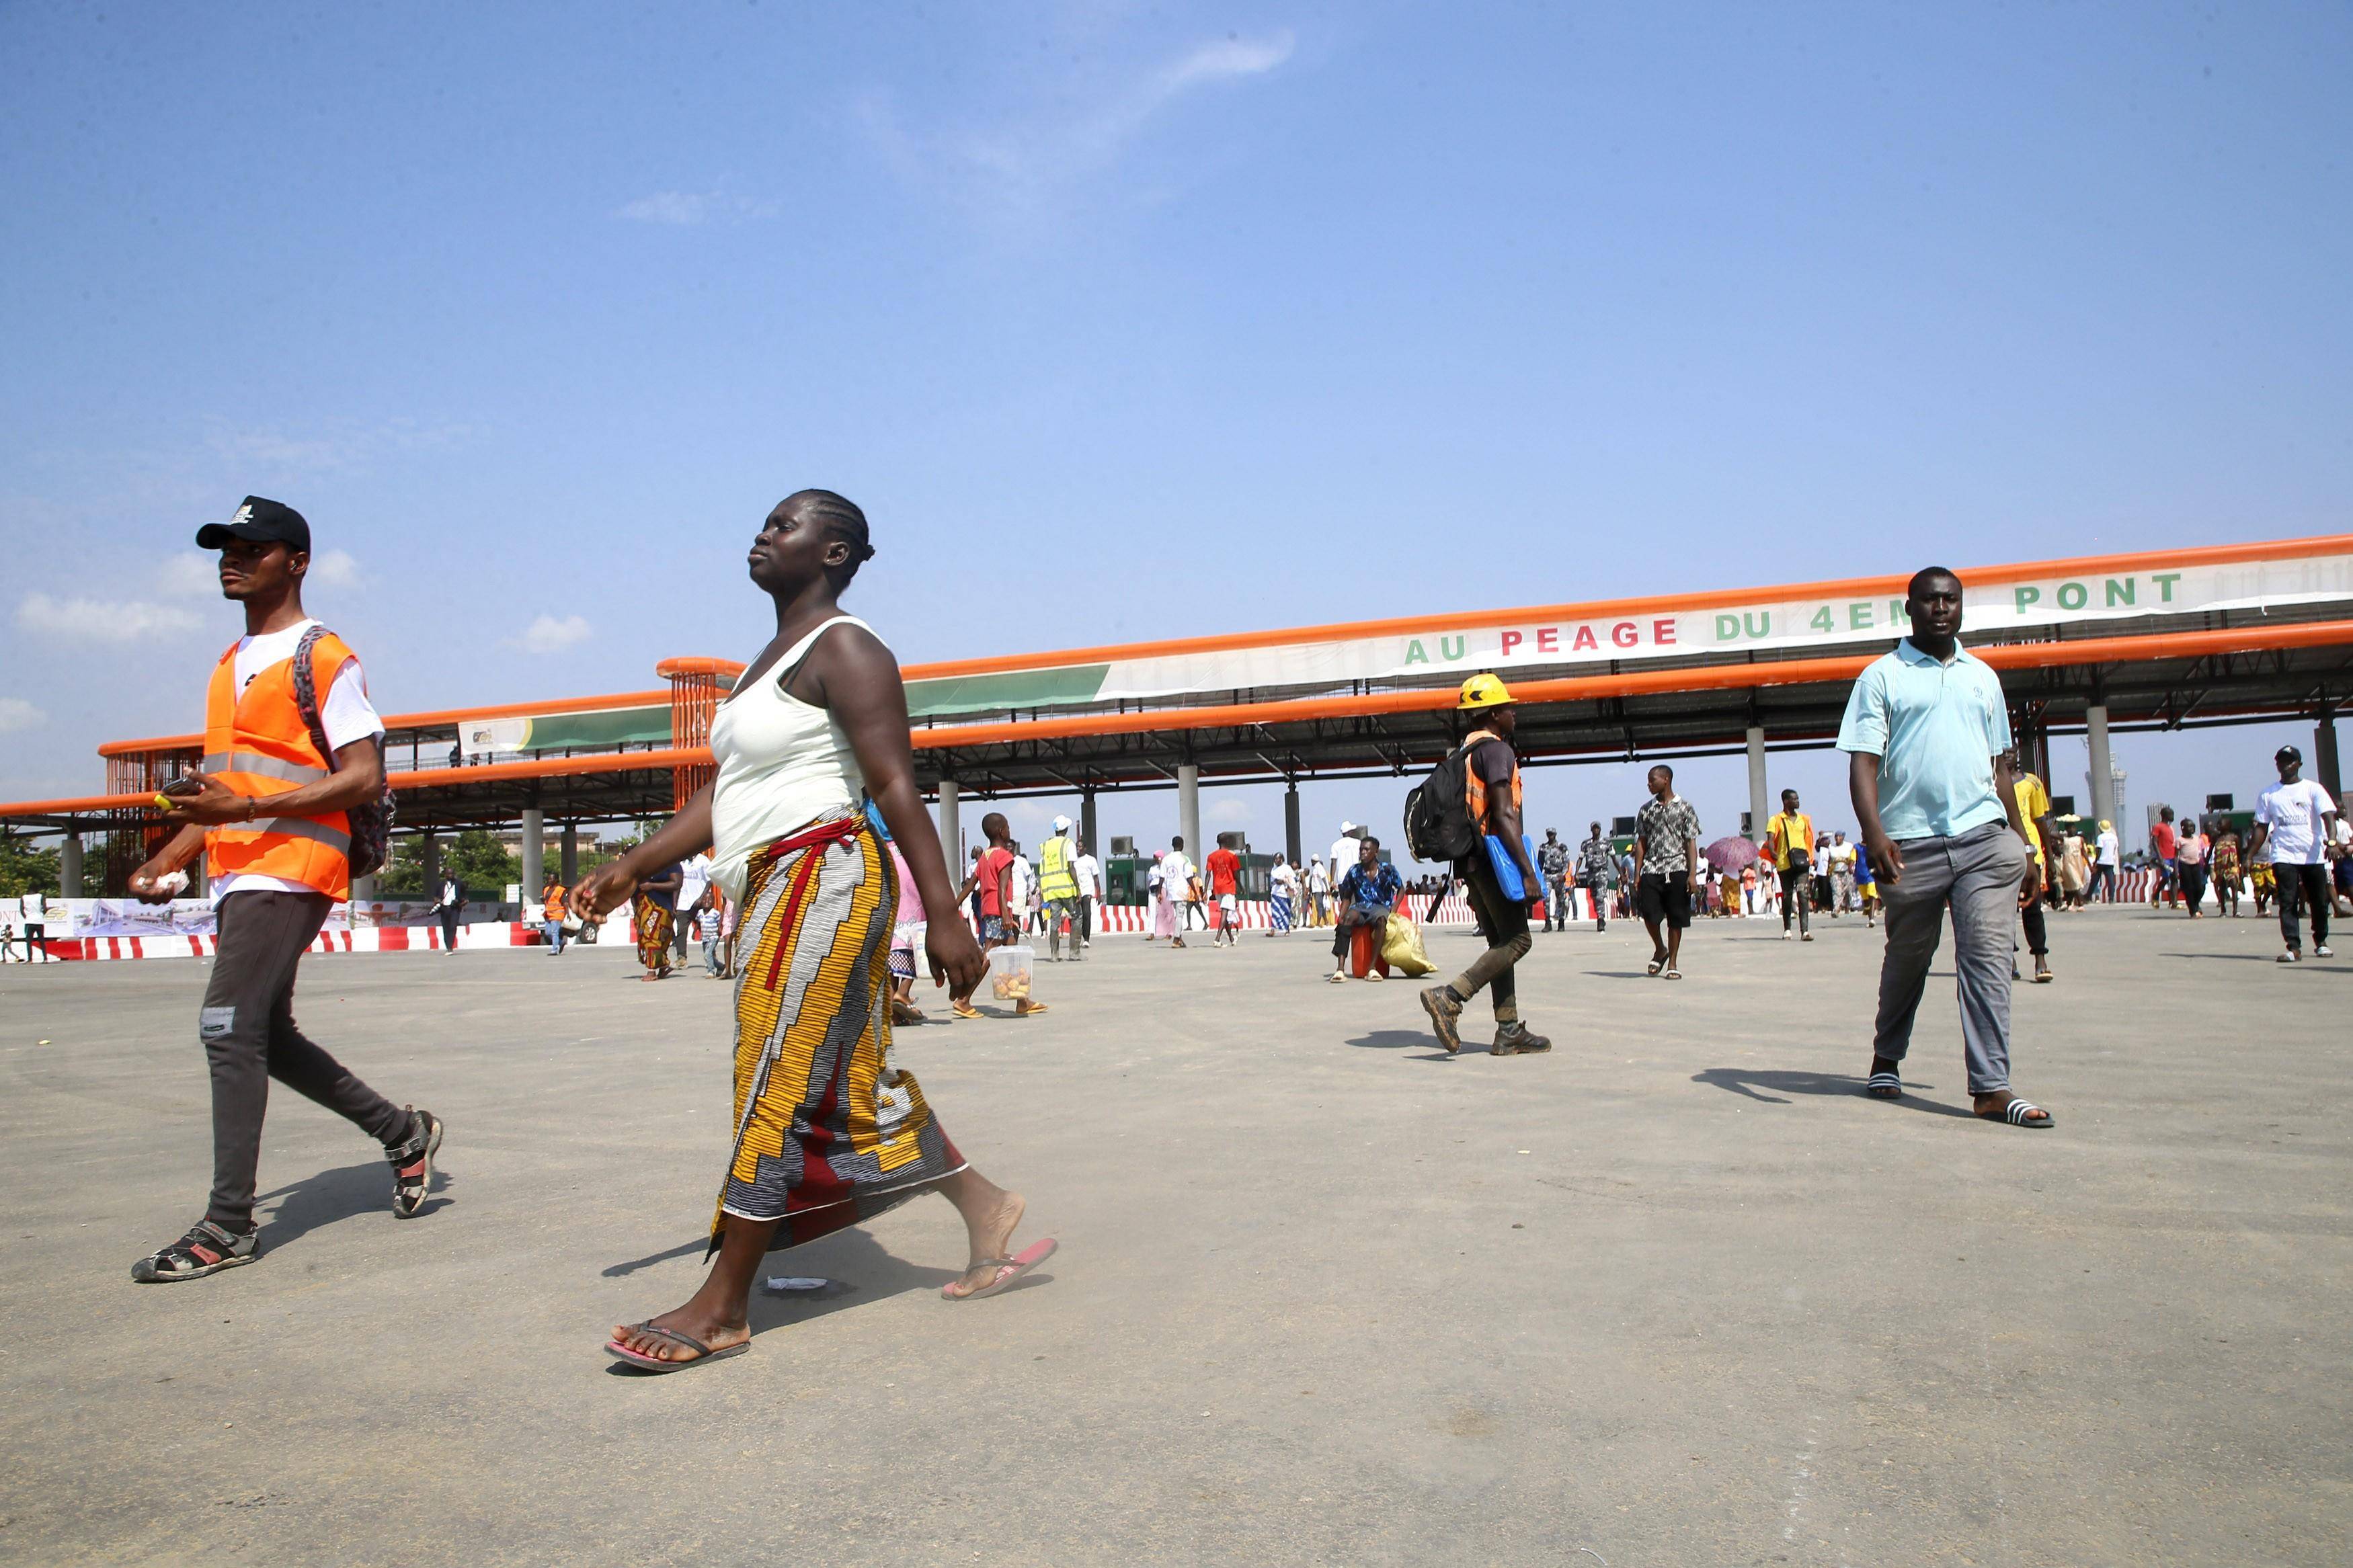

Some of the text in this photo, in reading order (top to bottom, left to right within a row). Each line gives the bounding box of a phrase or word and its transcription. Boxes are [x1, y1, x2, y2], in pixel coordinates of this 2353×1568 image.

[1405, 636, 1465, 665] AU
[1501, 619, 1677, 656] PEAGE
[1715, 612, 1771, 641] DU
[2015, 573, 2181, 614] PONT
